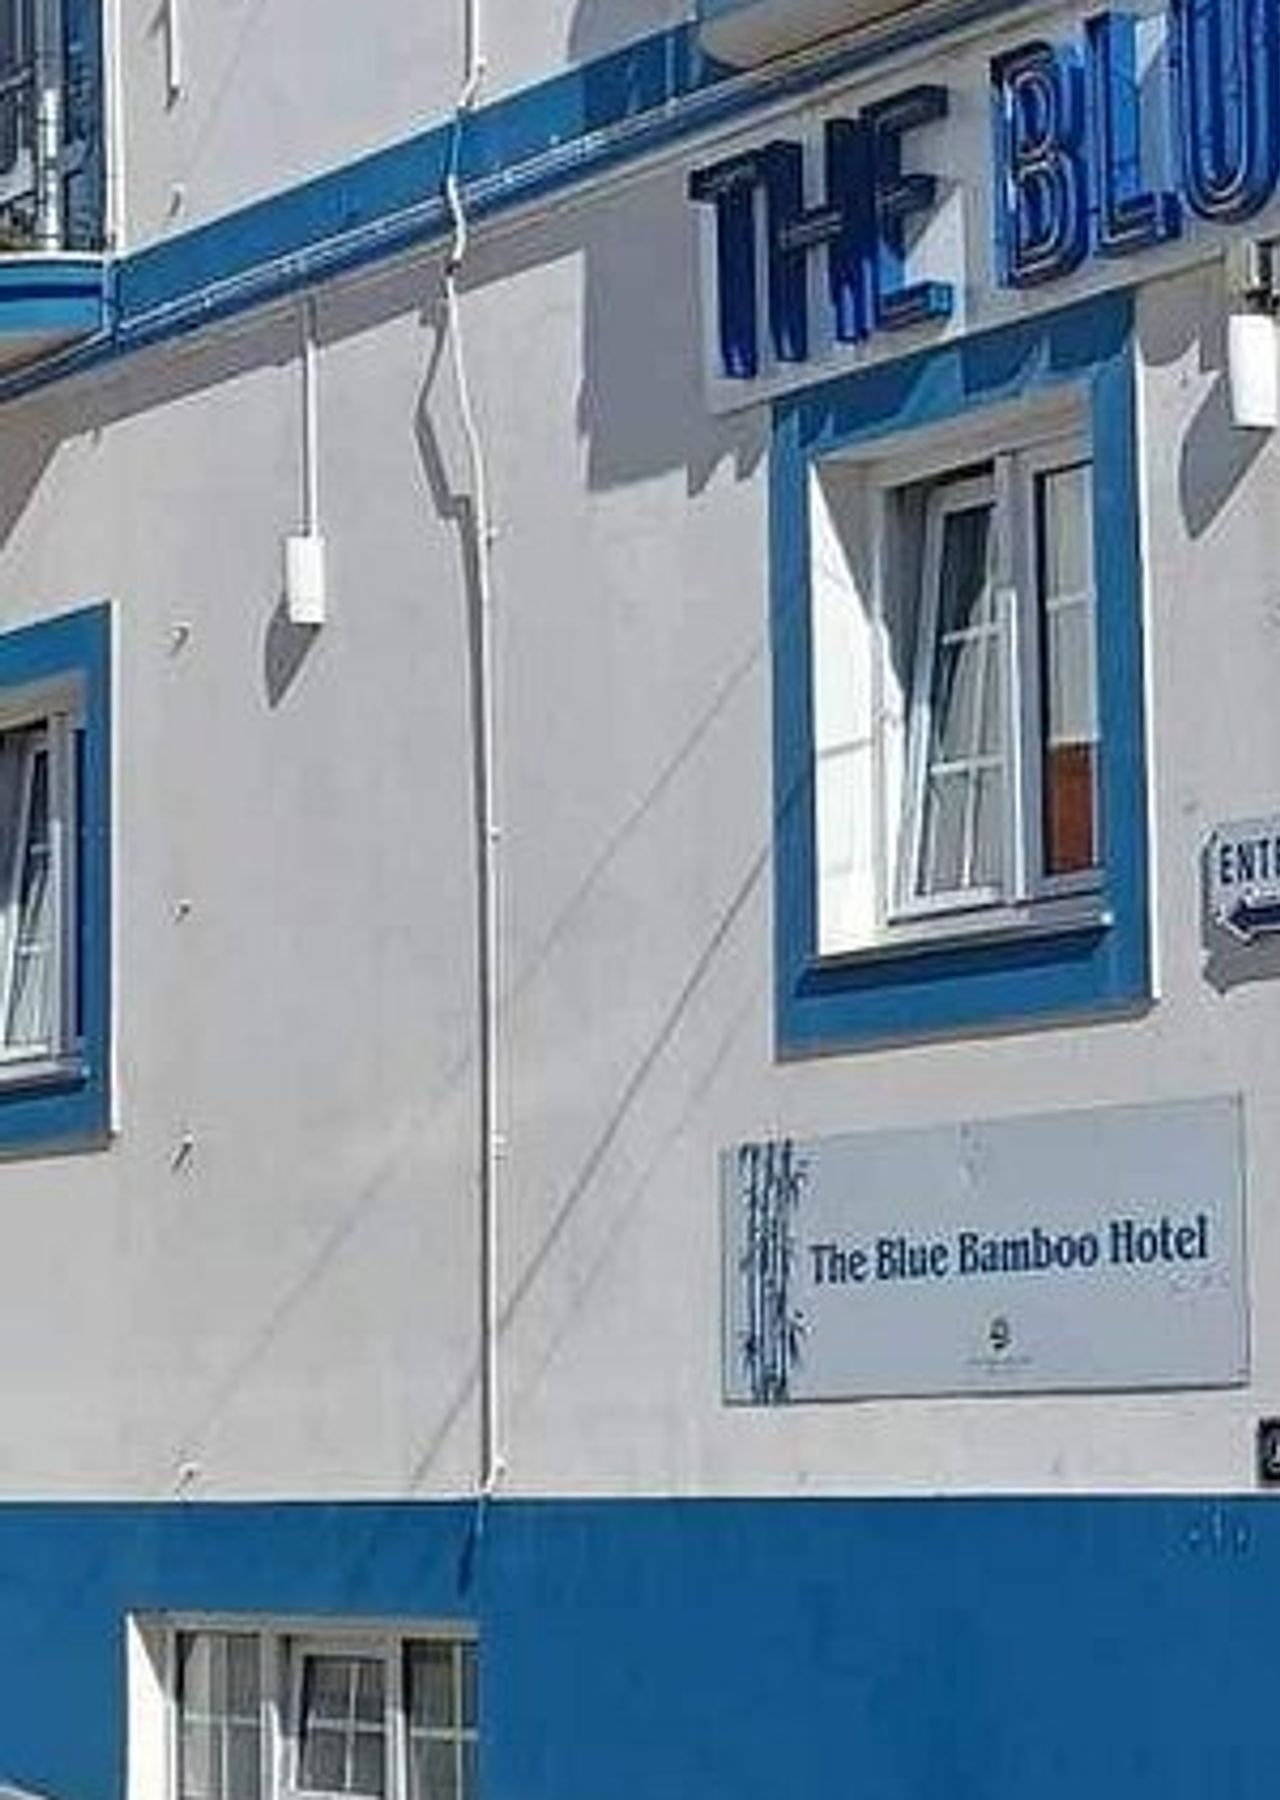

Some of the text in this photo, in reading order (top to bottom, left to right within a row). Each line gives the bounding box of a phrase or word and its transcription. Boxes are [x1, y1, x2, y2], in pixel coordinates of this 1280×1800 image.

[688, 84, 955, 380] THE
[809, 1214, 1209, 1285] The Blue Bamboo Hotel
